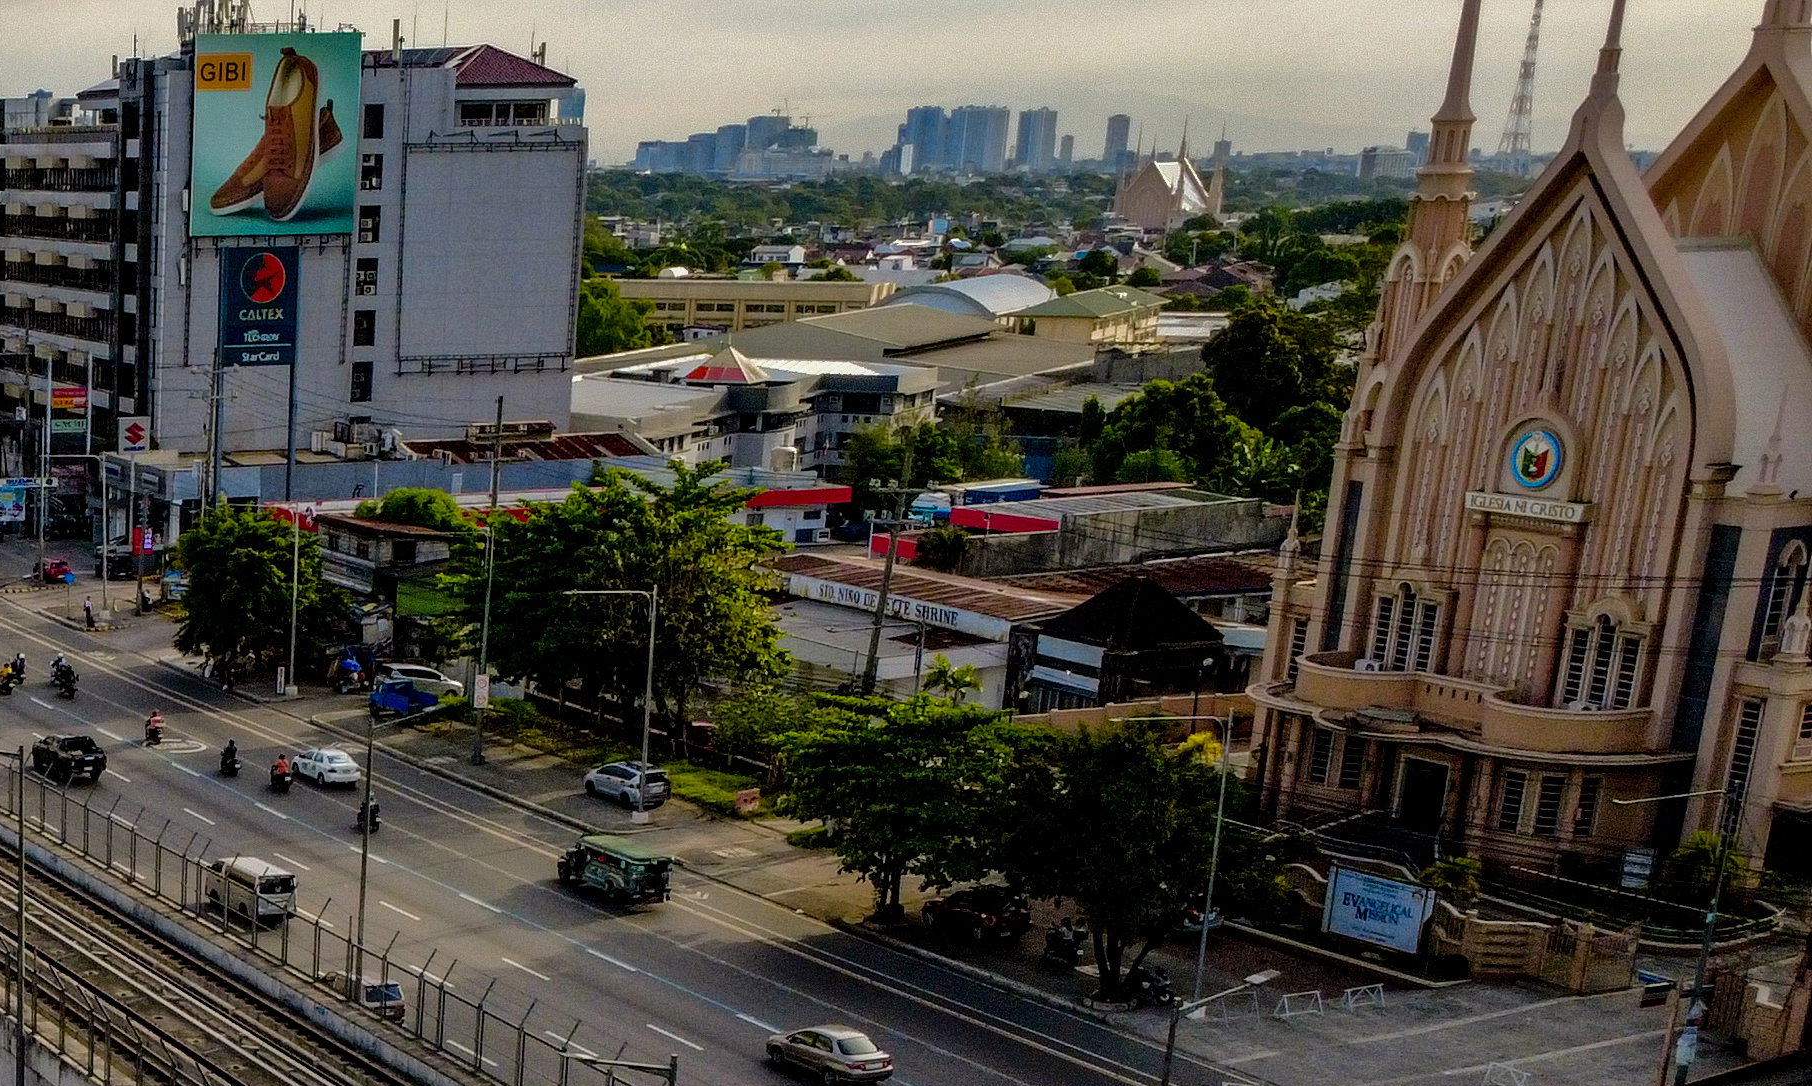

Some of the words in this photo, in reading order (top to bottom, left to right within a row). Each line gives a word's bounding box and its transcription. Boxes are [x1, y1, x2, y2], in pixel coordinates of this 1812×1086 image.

[200, 61, 247, 82] GIBI
[239, 308, 285, 321] CALTEX
[242, 351, 280, 361] StarCard
[1471, 494, 1511, 512] IGLESIA
[1515, 500, 1527, 513] NI
[1530, 502, 1575, 519] CRISTO
[864, 592, 877, 609] DE
[915, 603, 959, 626] SHRINE
[1343, 891, 1413, 918] EVANGELICAL
[1355, 905, 1399, 925] MISSION
